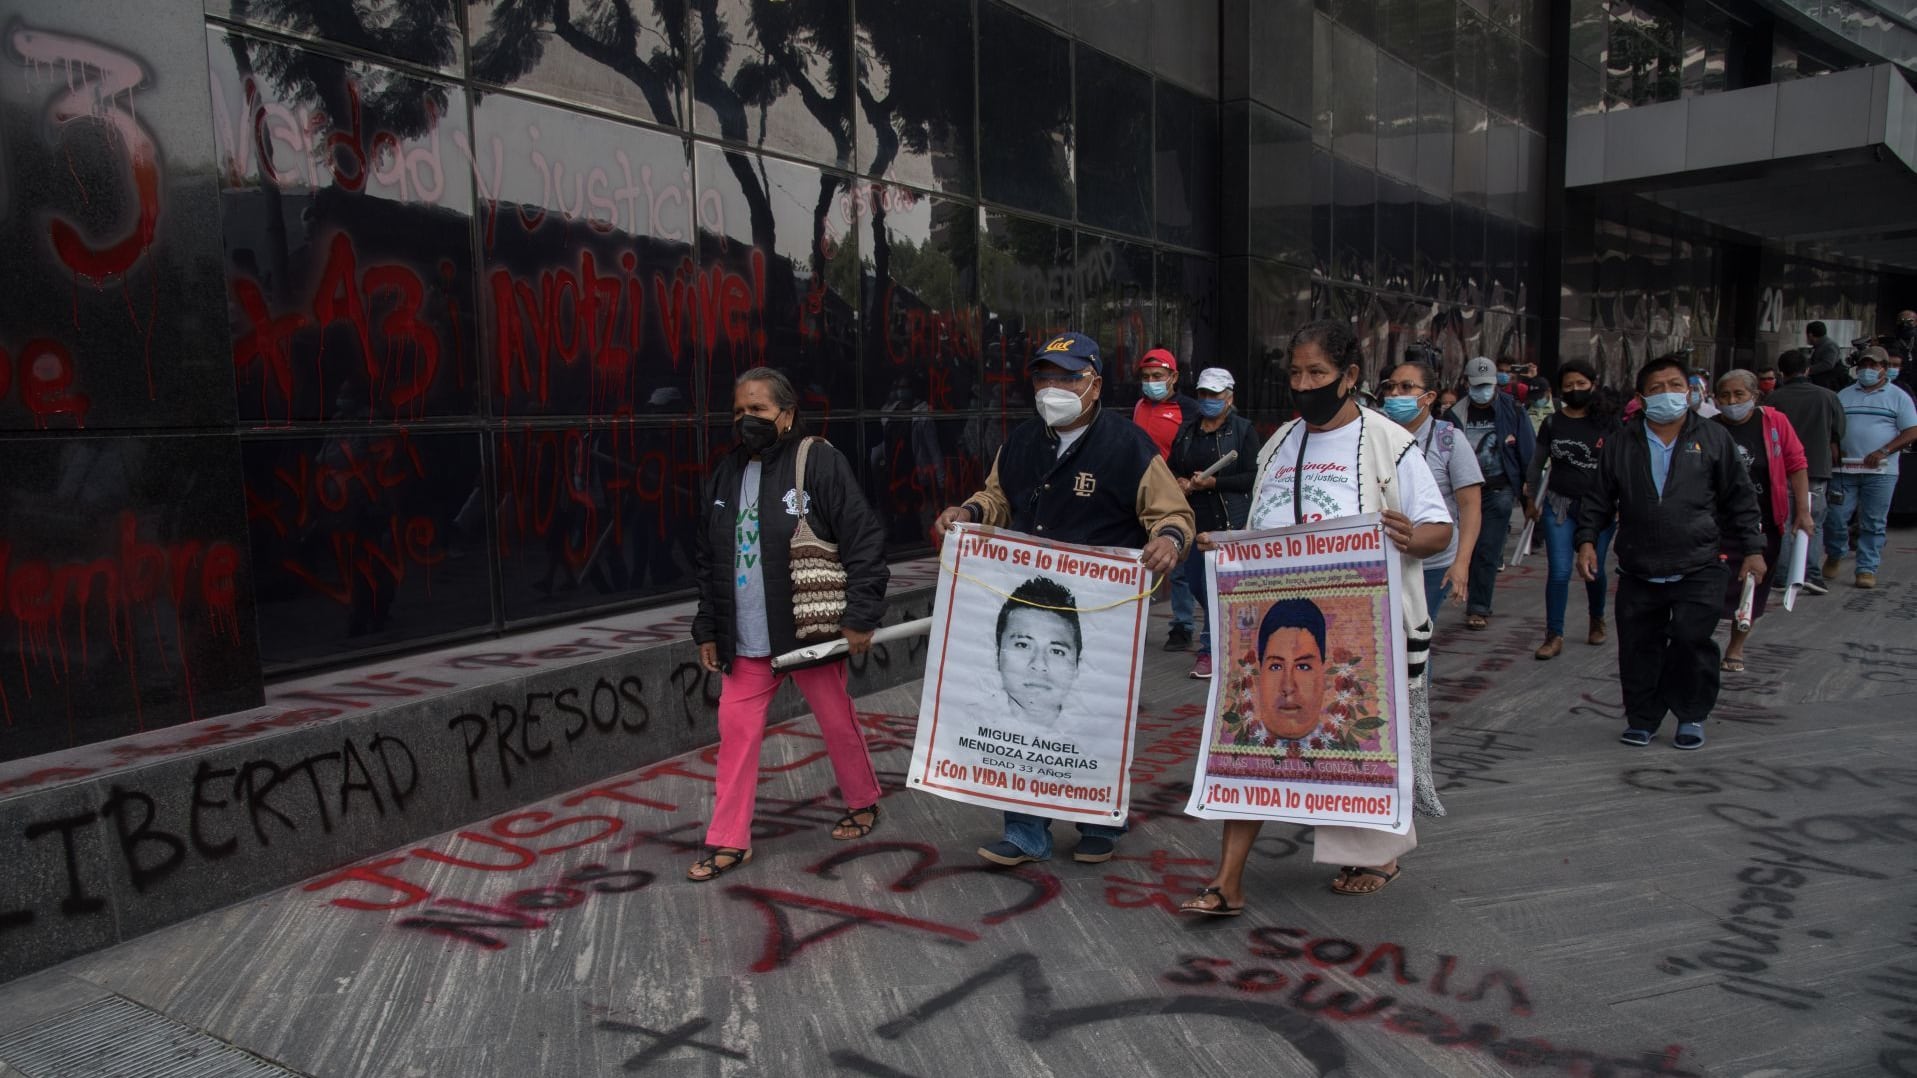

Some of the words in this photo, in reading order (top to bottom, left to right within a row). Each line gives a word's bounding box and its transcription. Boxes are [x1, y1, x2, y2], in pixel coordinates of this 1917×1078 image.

[1759, 286, 1784, 334] 20
[1044, 337, 1075, 353] Cal
[963, 537, 1008, 562] ¡Vivo
[1012, 548, 1030, 566] se
[1035, 550, 1052, 570] lo
[1056, 553, 1137, 586] llevaron!
[1218, 541, 1261, 565] ¡Vivo
[1266, 540, 1282, 558] se
[1286, 535, 1302, 556] lo
[1306, 528, 1380, 555] llevaron!
[448, 674, 650, 801] PRESOS
[958, 737, 1023, 760] MENDOZA
[1026, 752, 1098, 770] ZACARIAS
[978, 726, 1027, 746] MIGUEL
[1032, 737, 1079, 754] ÁNGEL
[934, 759, 967, 780] ¡Con
[972, 765, 1008, 789] VIDA
[1012, 773, 1026, 791] lo
[1030, 779, 1112, 803] queremos!
[982, 757, 1015, 769] EDAD
[1018, 765, 1033, 773] 33
[1038, 767, 1072, 779] AÑOS
[1255, 759, 1311, 771] TRUJILLO
[1206, 784, 1239, 805] ¡Con
[1244, 786, 1281, 808] VIDA
[1286, 790, 1300, 808] lo
[1305, 793, 1391, 815] queremos!
